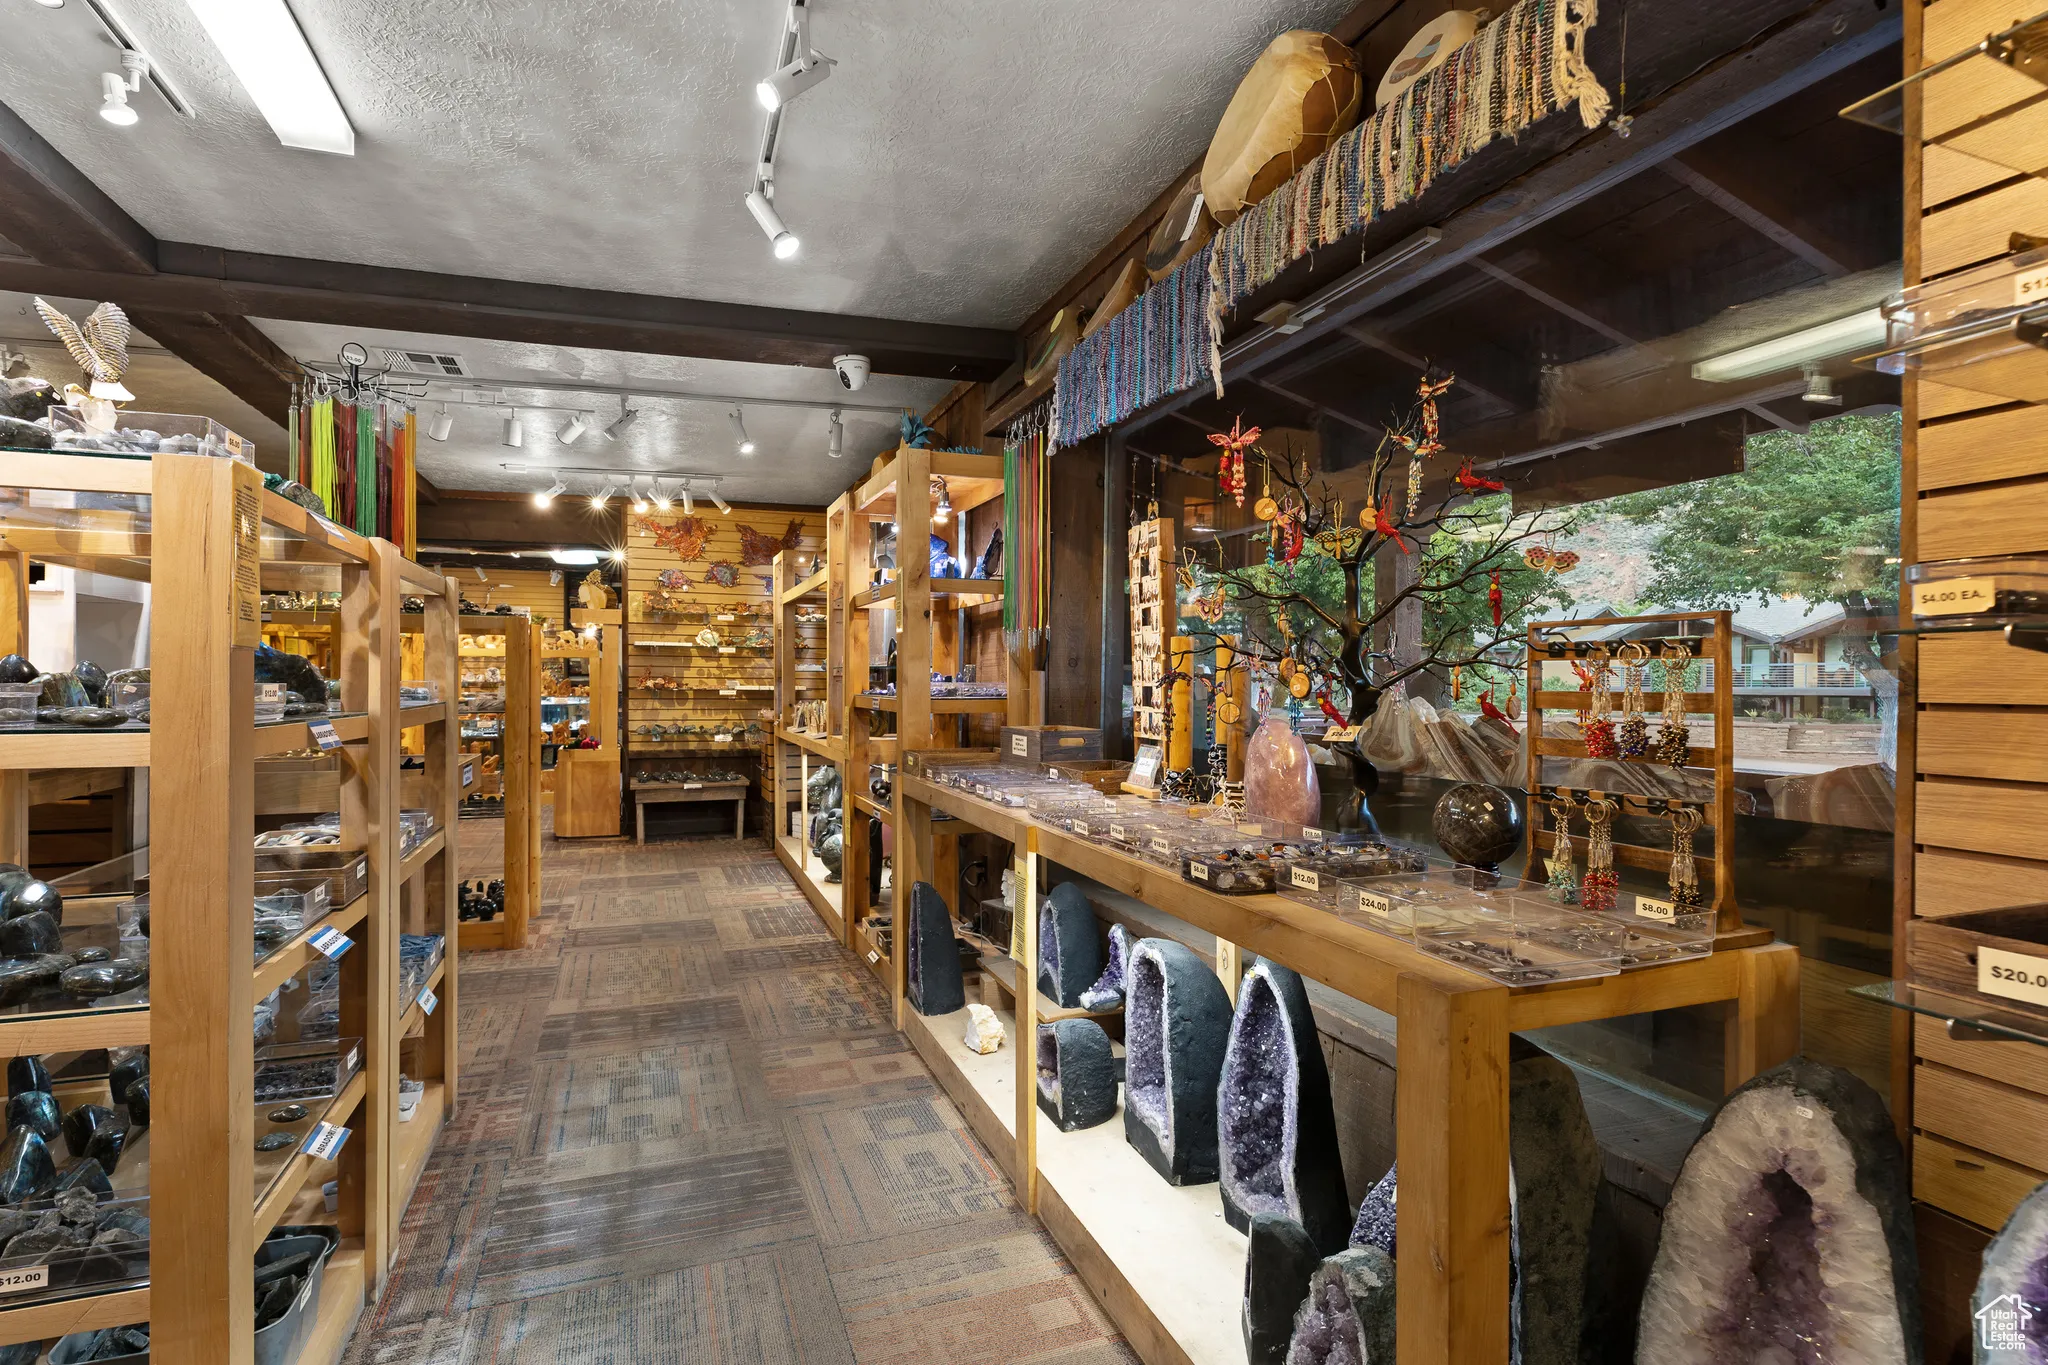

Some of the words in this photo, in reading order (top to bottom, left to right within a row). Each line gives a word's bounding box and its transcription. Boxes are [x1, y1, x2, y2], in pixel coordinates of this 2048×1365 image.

[1921, 591, 1957, 604] $4.00
[1293, 872, 1316, 885] $12.00
[1361, 897, 1387, 912] $24.00
[1642, 903, 1668, 915] $8.00
[320, 931, 345, 953] LABRADORITE
[1991, 965, 2048, 988] $20.0
[0, 1272, 41, 1287] $12.00
